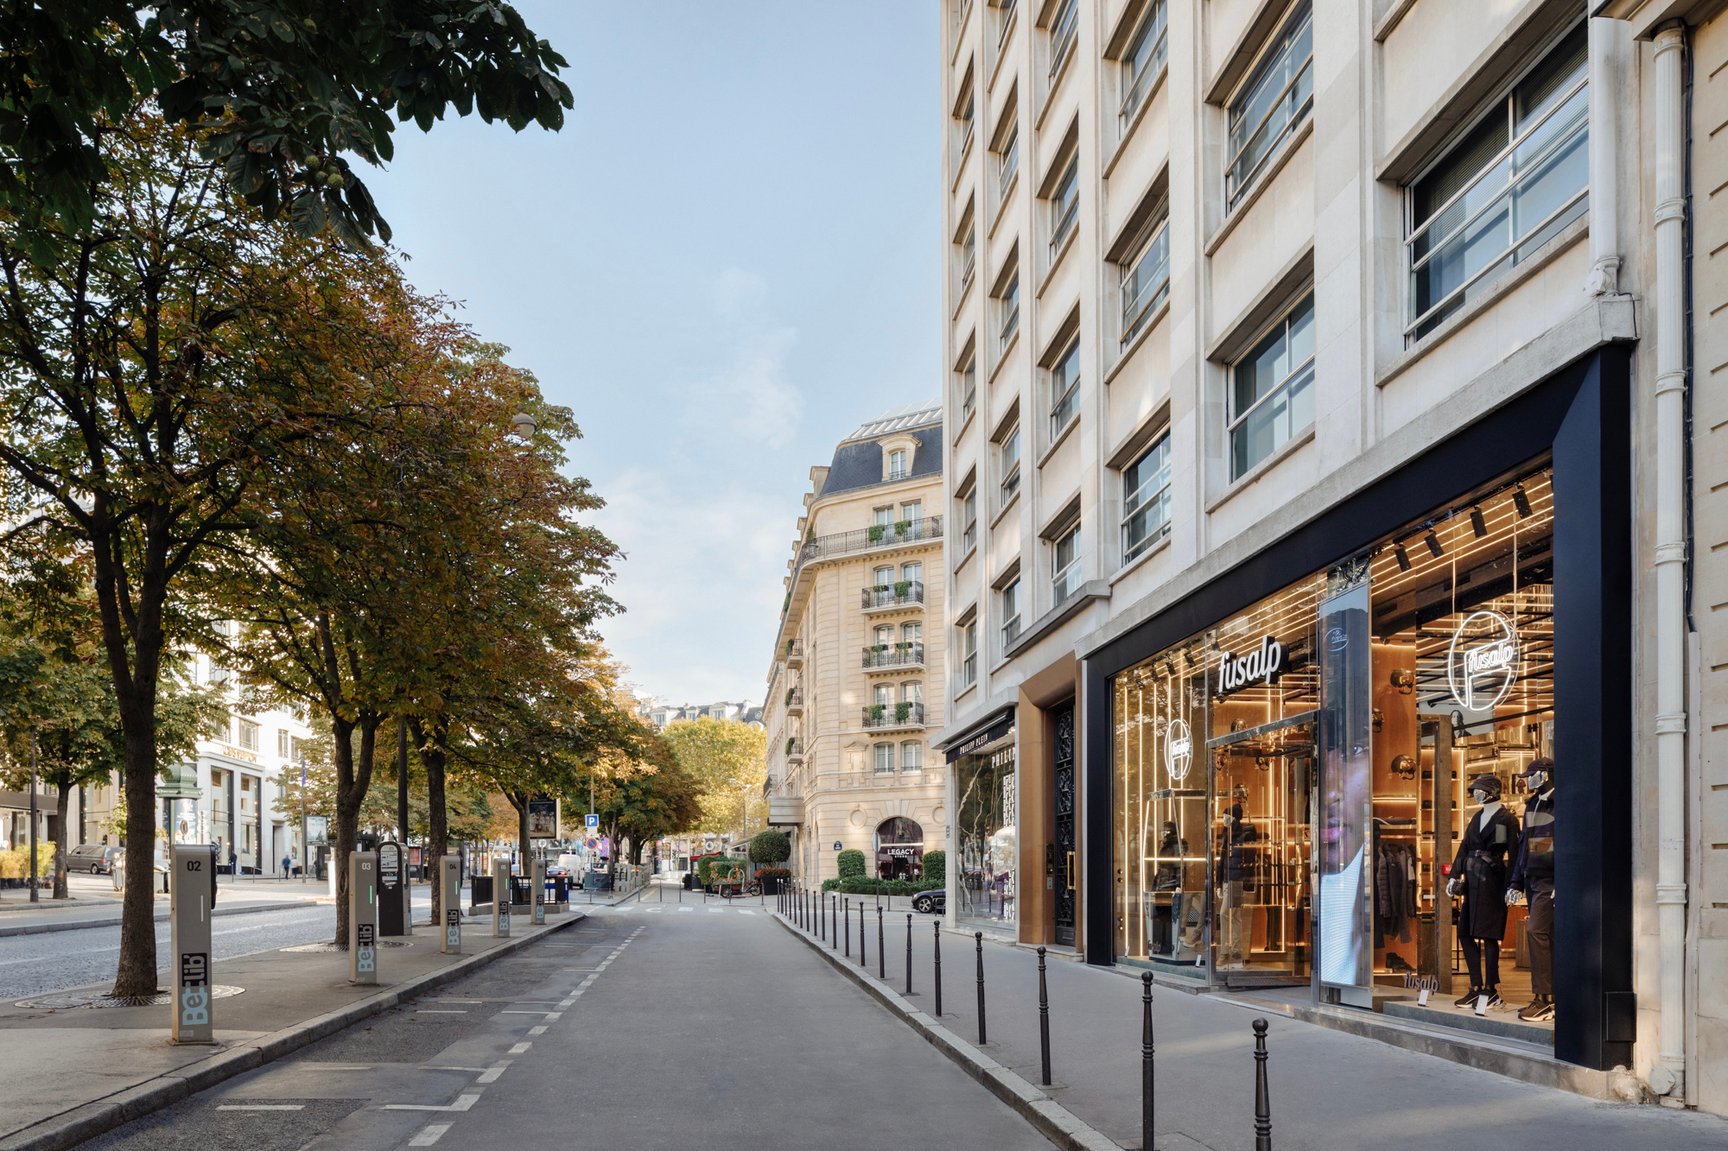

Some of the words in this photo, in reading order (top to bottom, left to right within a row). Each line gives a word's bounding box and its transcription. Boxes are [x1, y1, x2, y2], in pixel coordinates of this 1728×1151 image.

[1218, 635, 1281, 693] fusalp
[1467, 643, 1514, 674] fusalp
[187, 860, 202, 872] 02
[361, 862, 372, 871] 03
[1403, 970, 1440, 995] fusalp
